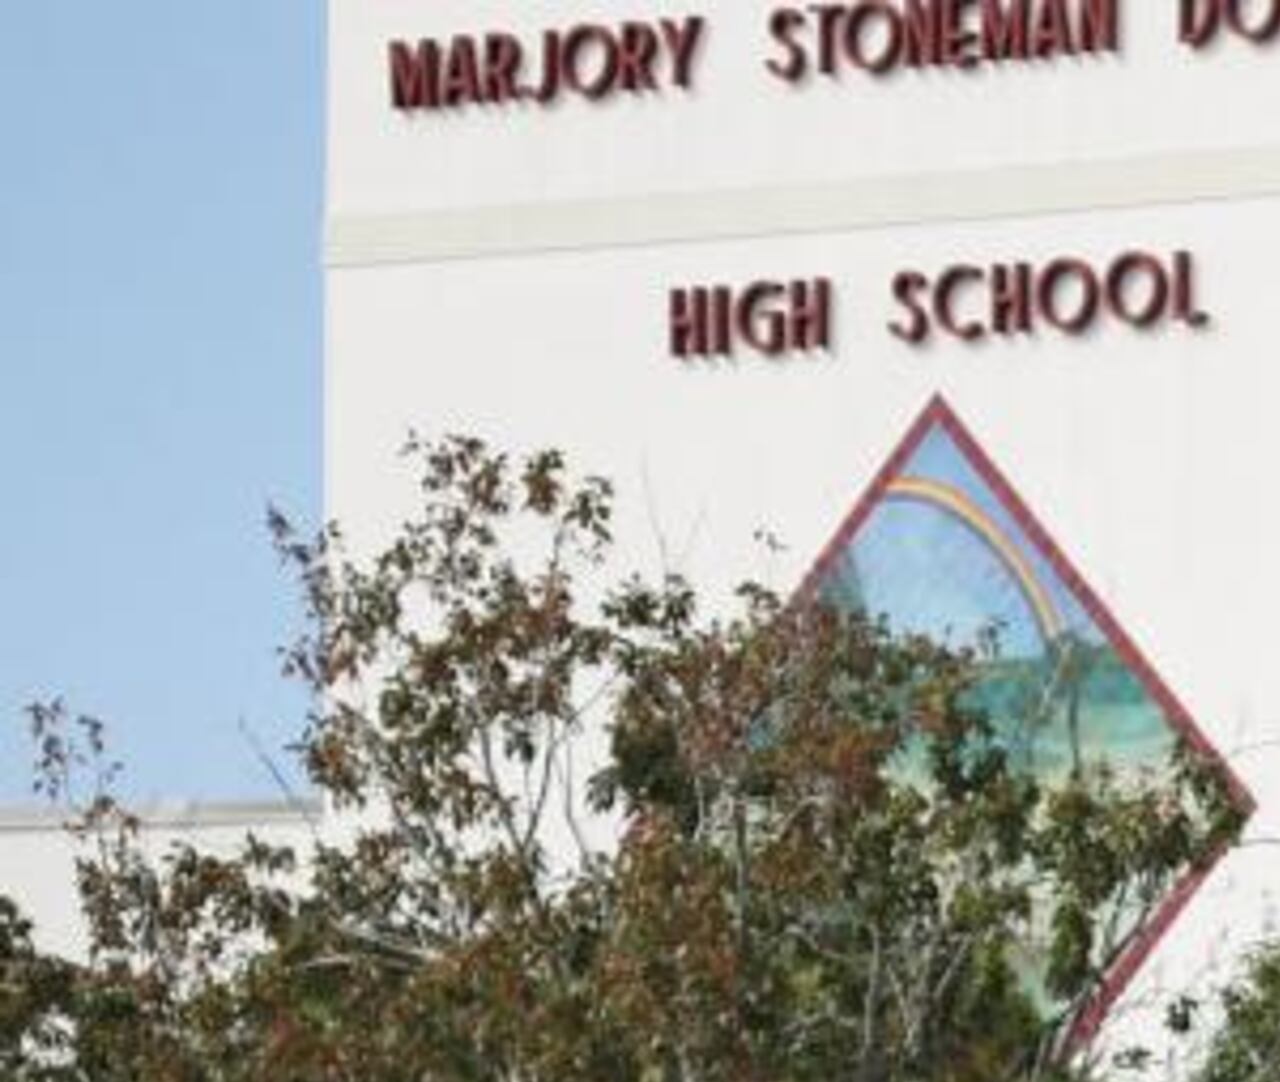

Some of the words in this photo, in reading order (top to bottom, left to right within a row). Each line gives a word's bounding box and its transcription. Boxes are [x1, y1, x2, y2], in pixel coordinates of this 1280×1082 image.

[388, 16, 704, 110] MARJORY
[764, 0, 1120, 81] STONEMAN
[669, 277, 832, 358] HIGH
[887, 250, 1210, 345] SCHOOL
